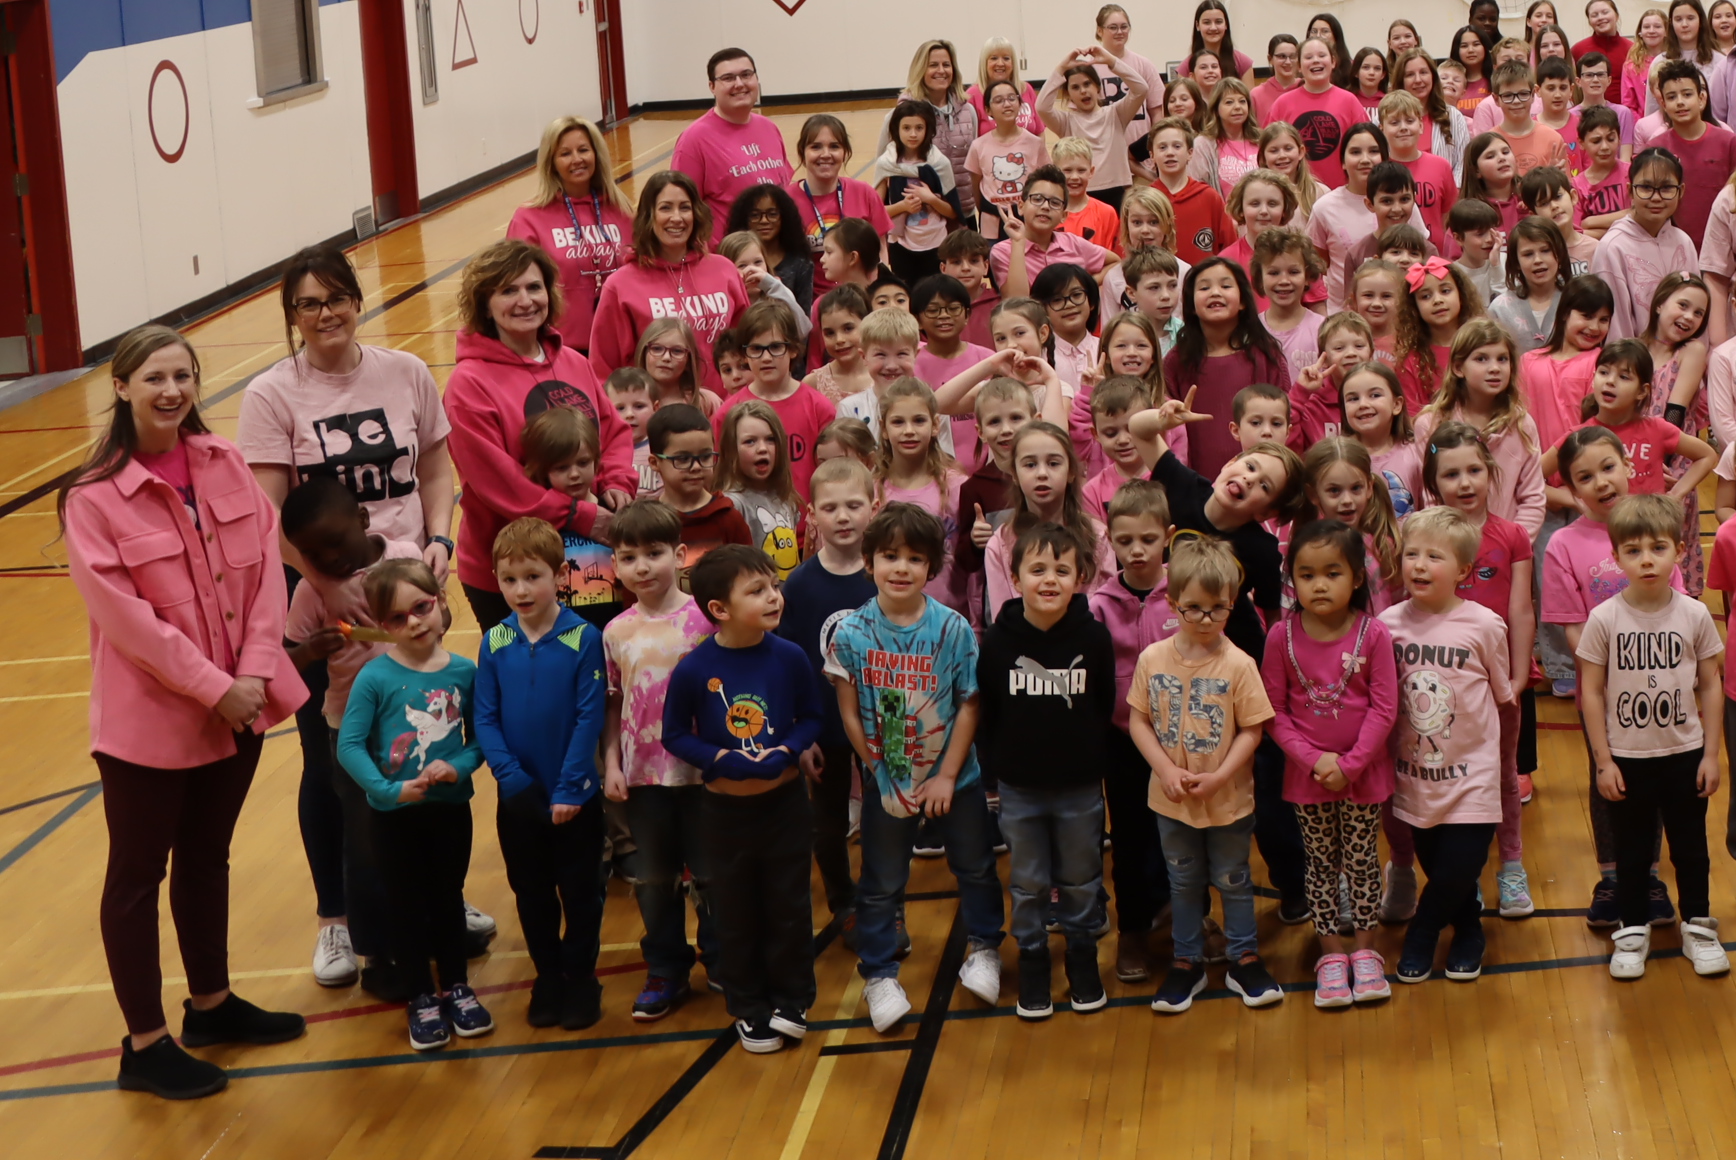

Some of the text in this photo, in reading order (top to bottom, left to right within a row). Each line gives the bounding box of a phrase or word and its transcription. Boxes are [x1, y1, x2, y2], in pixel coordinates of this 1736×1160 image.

[741, 144, 762, 157] Lift
[729, 161, 757, 177] Each
[551, 223, 622, 249] BE KIND
[649, 291, 730, 320] BE KIND
[319, 418, 387, 459] be
[1616, 631, 1684, 671] KIND
[1008, 668, 1087, 696] PUMA
[1647, 674, 1658, 690] IS
[1148, 673, 1230, 753] 05
[1616, 691, 1687, 729] COOL
[1419, 764, 1469, 783] BULLY
